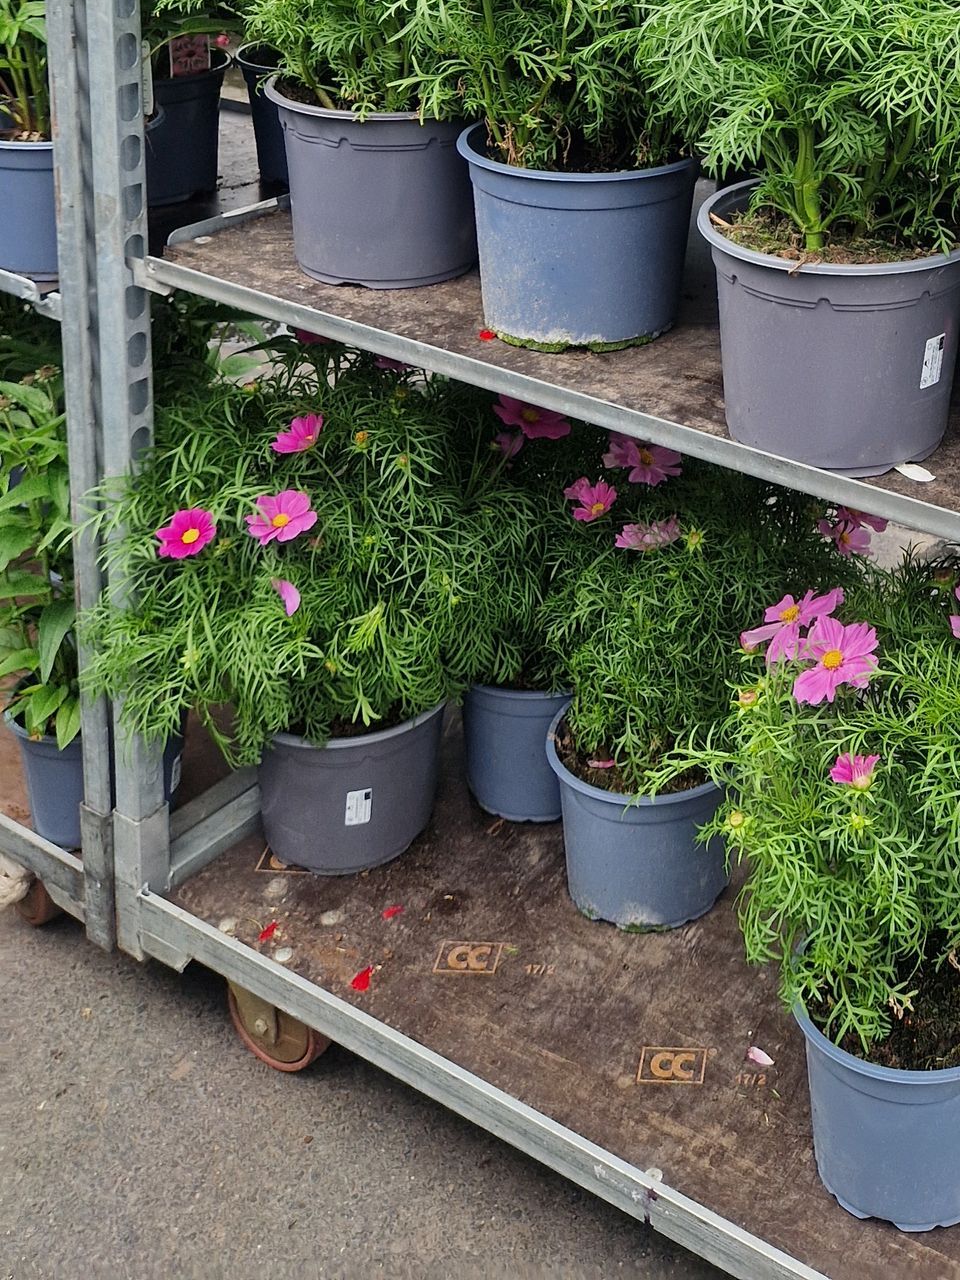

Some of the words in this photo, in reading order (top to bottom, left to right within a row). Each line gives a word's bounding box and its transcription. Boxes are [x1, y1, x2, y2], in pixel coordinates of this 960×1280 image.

[447, 945, 492, 970] CC
[524, 963, 555, 975] 17/2
[650, 1051, 696, 1079] CC
[735, 1073, 767, 1086] 17/2
